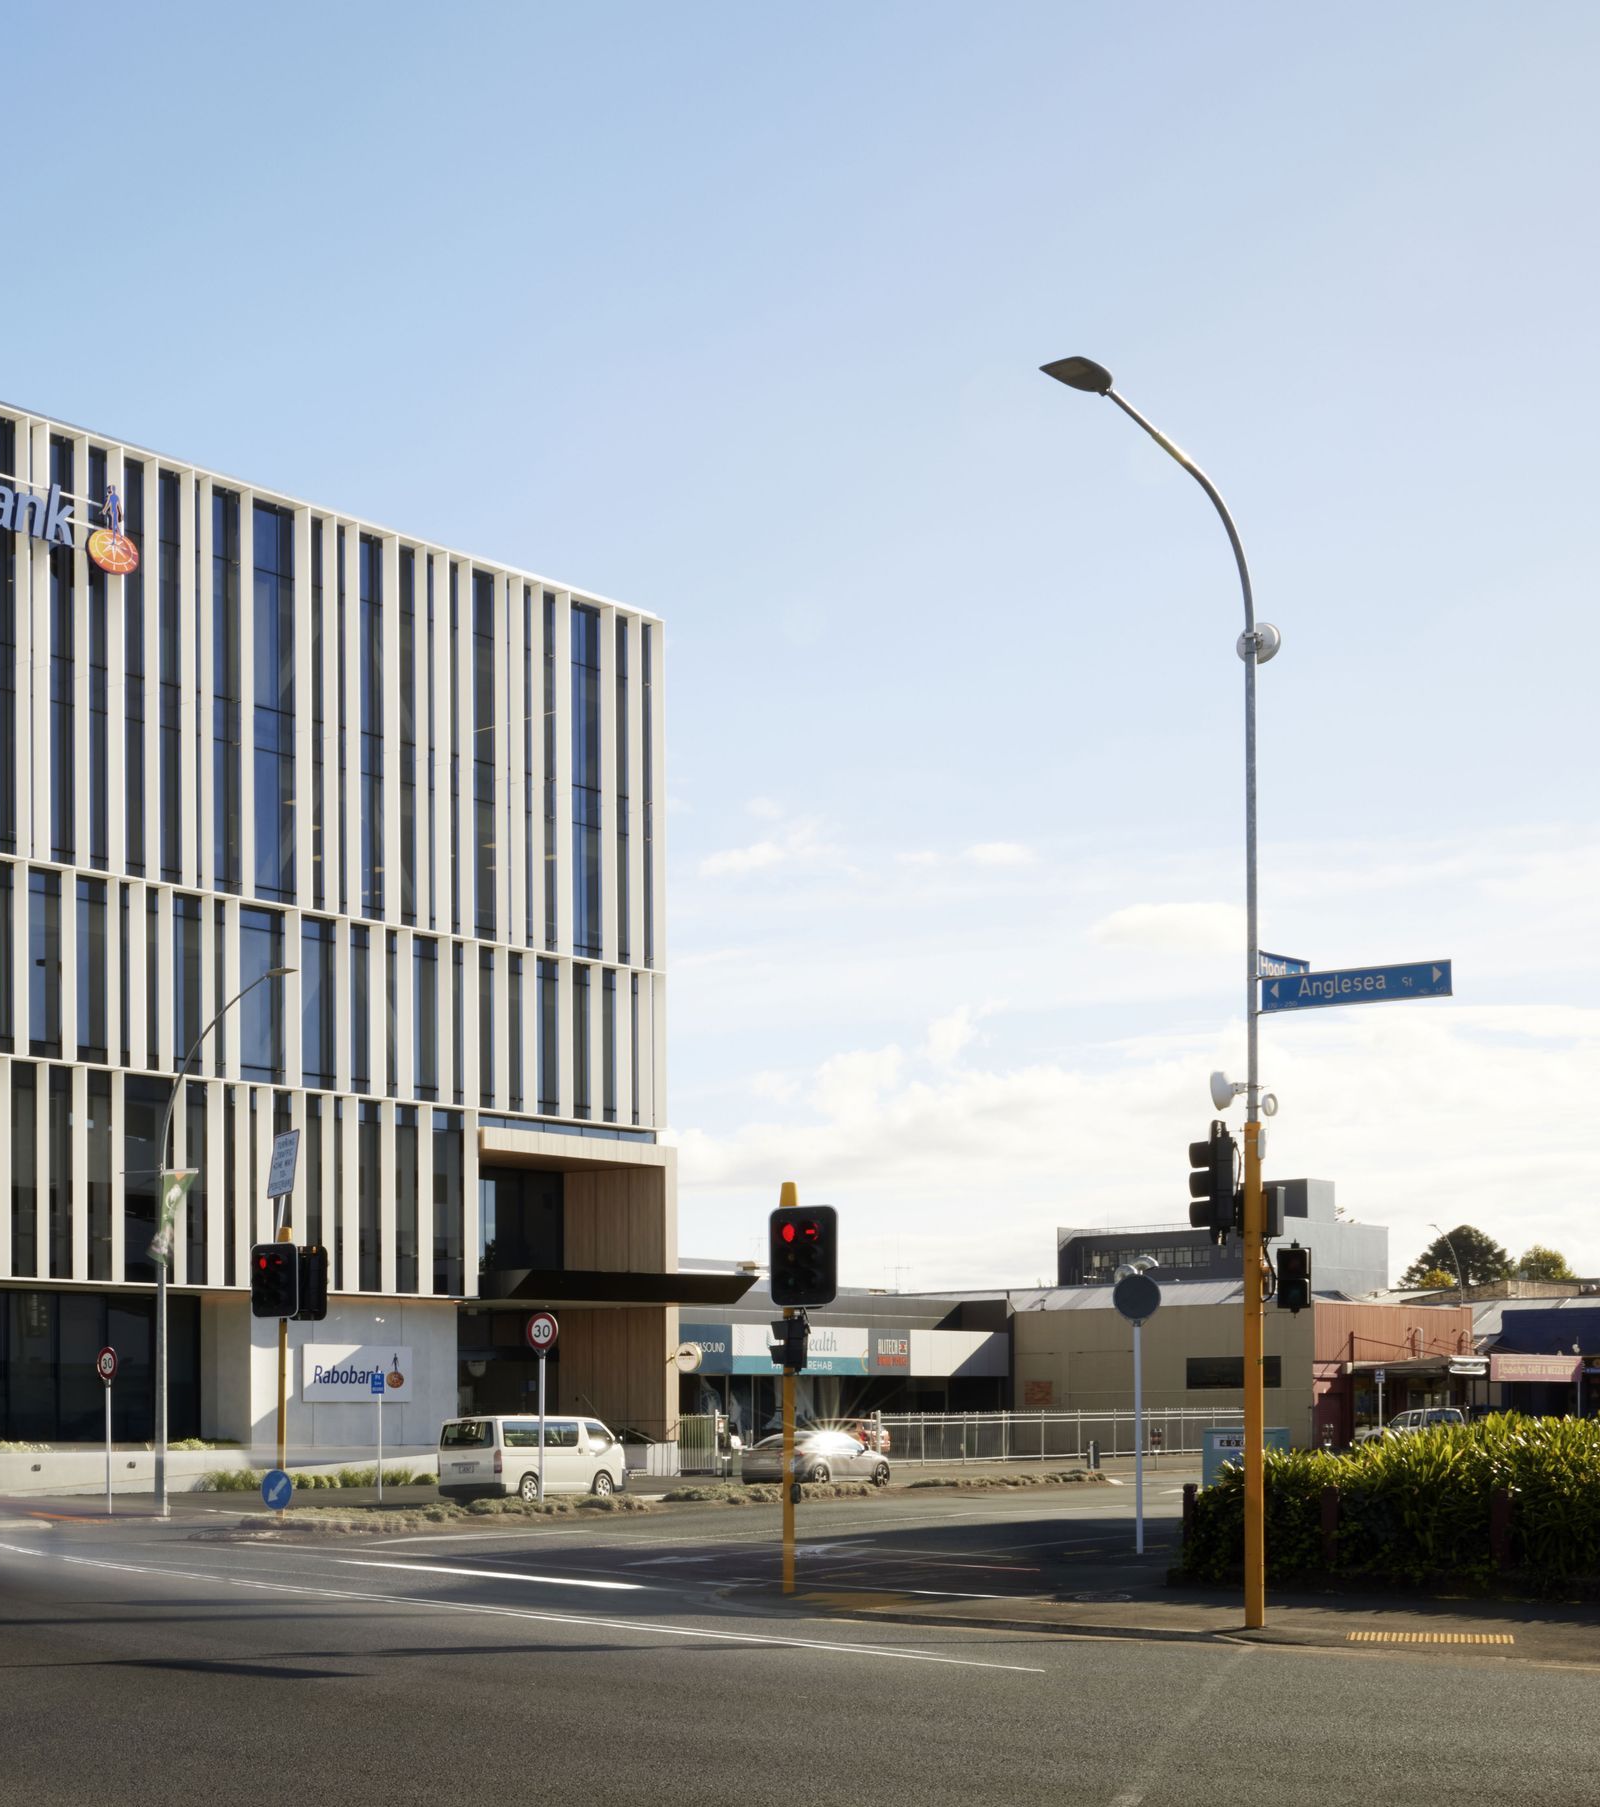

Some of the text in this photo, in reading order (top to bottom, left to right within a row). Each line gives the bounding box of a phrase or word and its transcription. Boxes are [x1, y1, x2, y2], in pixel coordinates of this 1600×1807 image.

[1298, 974, 1413, 998] Anglesea St
[534, 1324, 550, 1338] 30
[102, 1357, 112, 1369] 30
[807, 1360, 833, 1370] REHAB
